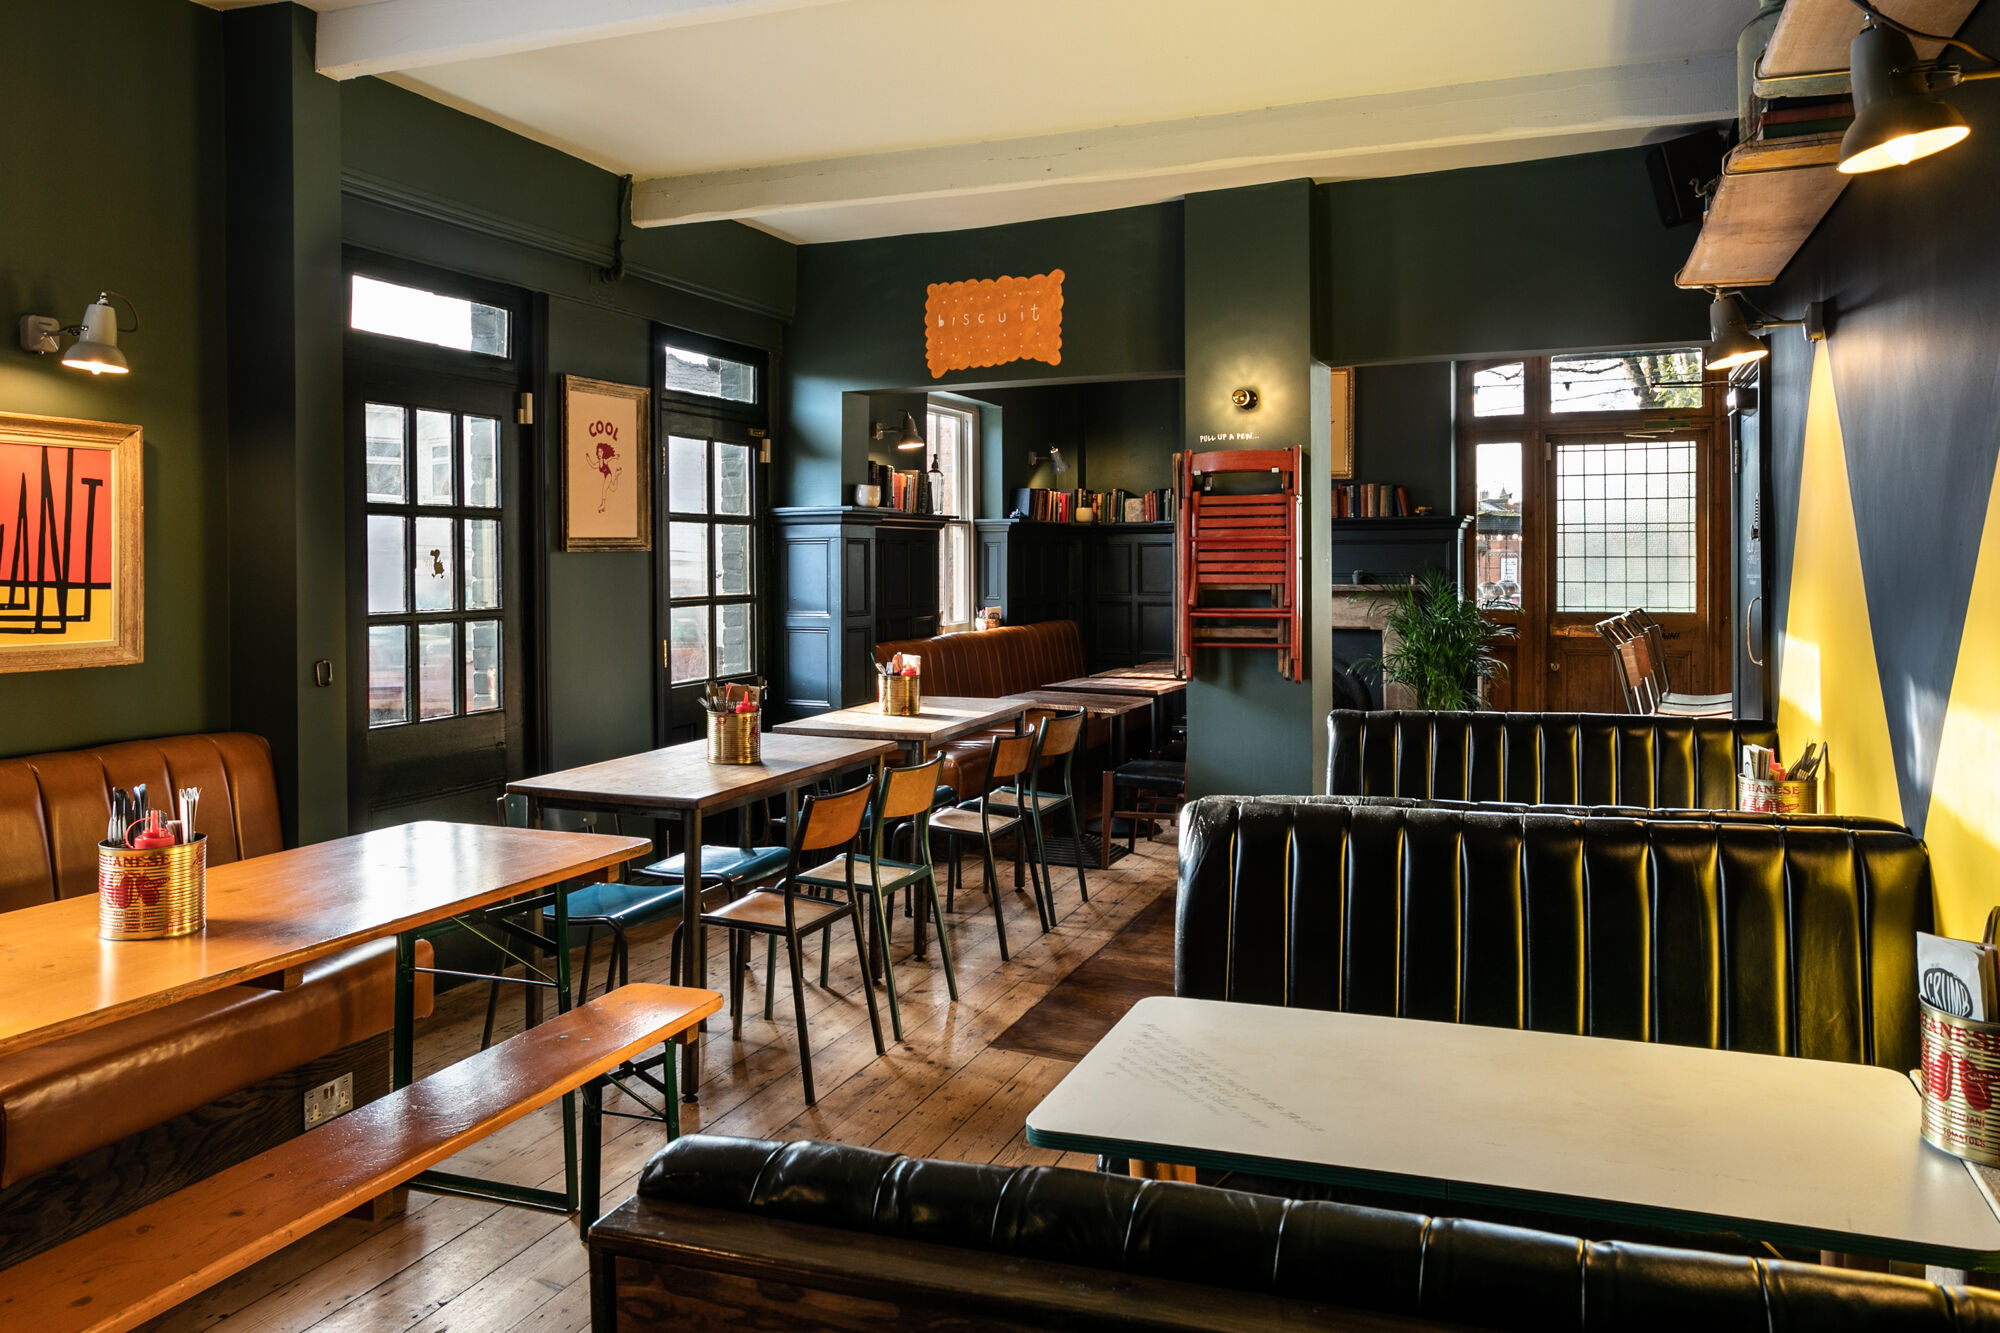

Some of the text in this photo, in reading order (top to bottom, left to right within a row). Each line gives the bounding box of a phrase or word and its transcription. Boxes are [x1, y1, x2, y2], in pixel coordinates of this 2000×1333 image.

[938, 304, 1039, 328] biscuit
[589, 420, 618, 441] COOL
[1199, 435, 1216, 443] PULL
[1217, 433, 1227, 441] UP
[1229, 433, 1235, 441] A
[0, 446, 103, 634] ANT
[1926, 971, 1970, 1017] CRUMB
